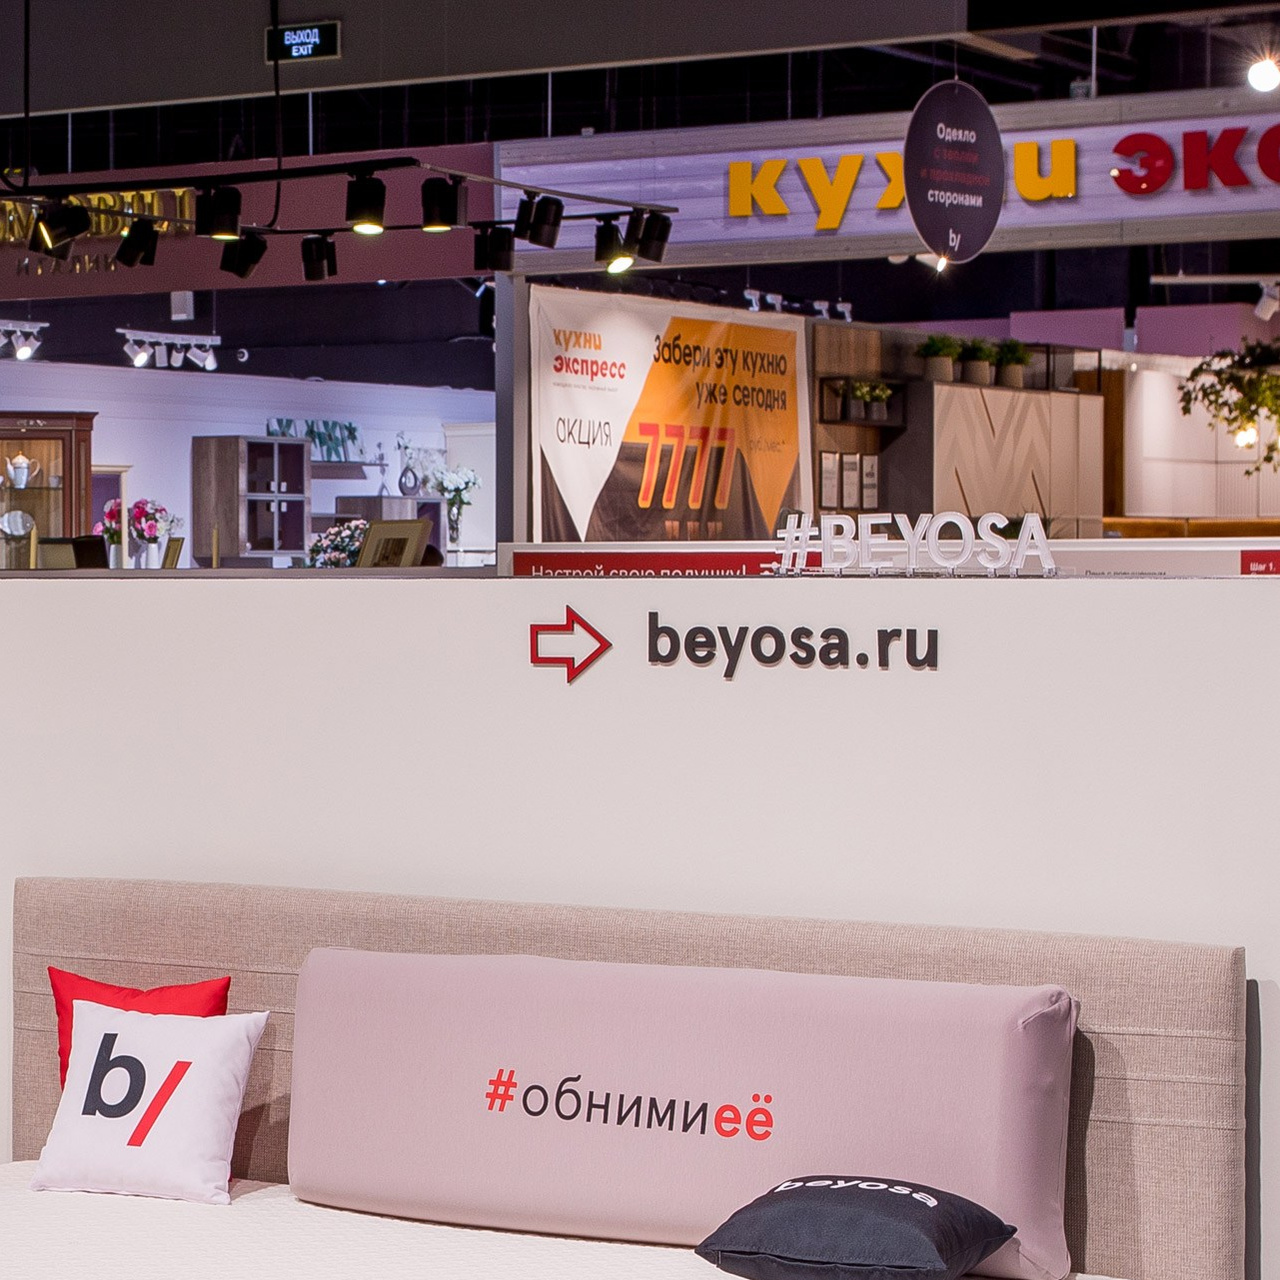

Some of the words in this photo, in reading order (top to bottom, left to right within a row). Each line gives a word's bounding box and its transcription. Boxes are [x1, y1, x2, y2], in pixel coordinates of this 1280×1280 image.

[284, 28, 319, 45] ВЫХОД
[292, 44, 313, 56] EXIT
[936, 122, 977, 144] Одеяло
[729, 139, 1077, 230] кухи
[927, 188, 983, 208] сторонами
[553, 328, 602, 351] кухни
[553, 354, 626, 382] экспресс
[653, 334, 711, 368] Забери
[715, 346, 738, 373] эту
[742, 350, 788, 378] кухню
[696, 381, 728, 410] уже
[732, 385, 787, 411] сегодня
[556, 416, 612, 450] акция
[637, 423, 736, 510] 7777
[776, 511, 1056, 570] #BEYOSA
[647, 611, 939, 681] beyosa.ru
[485, 1068, 774, 1141] #обнимиеё
